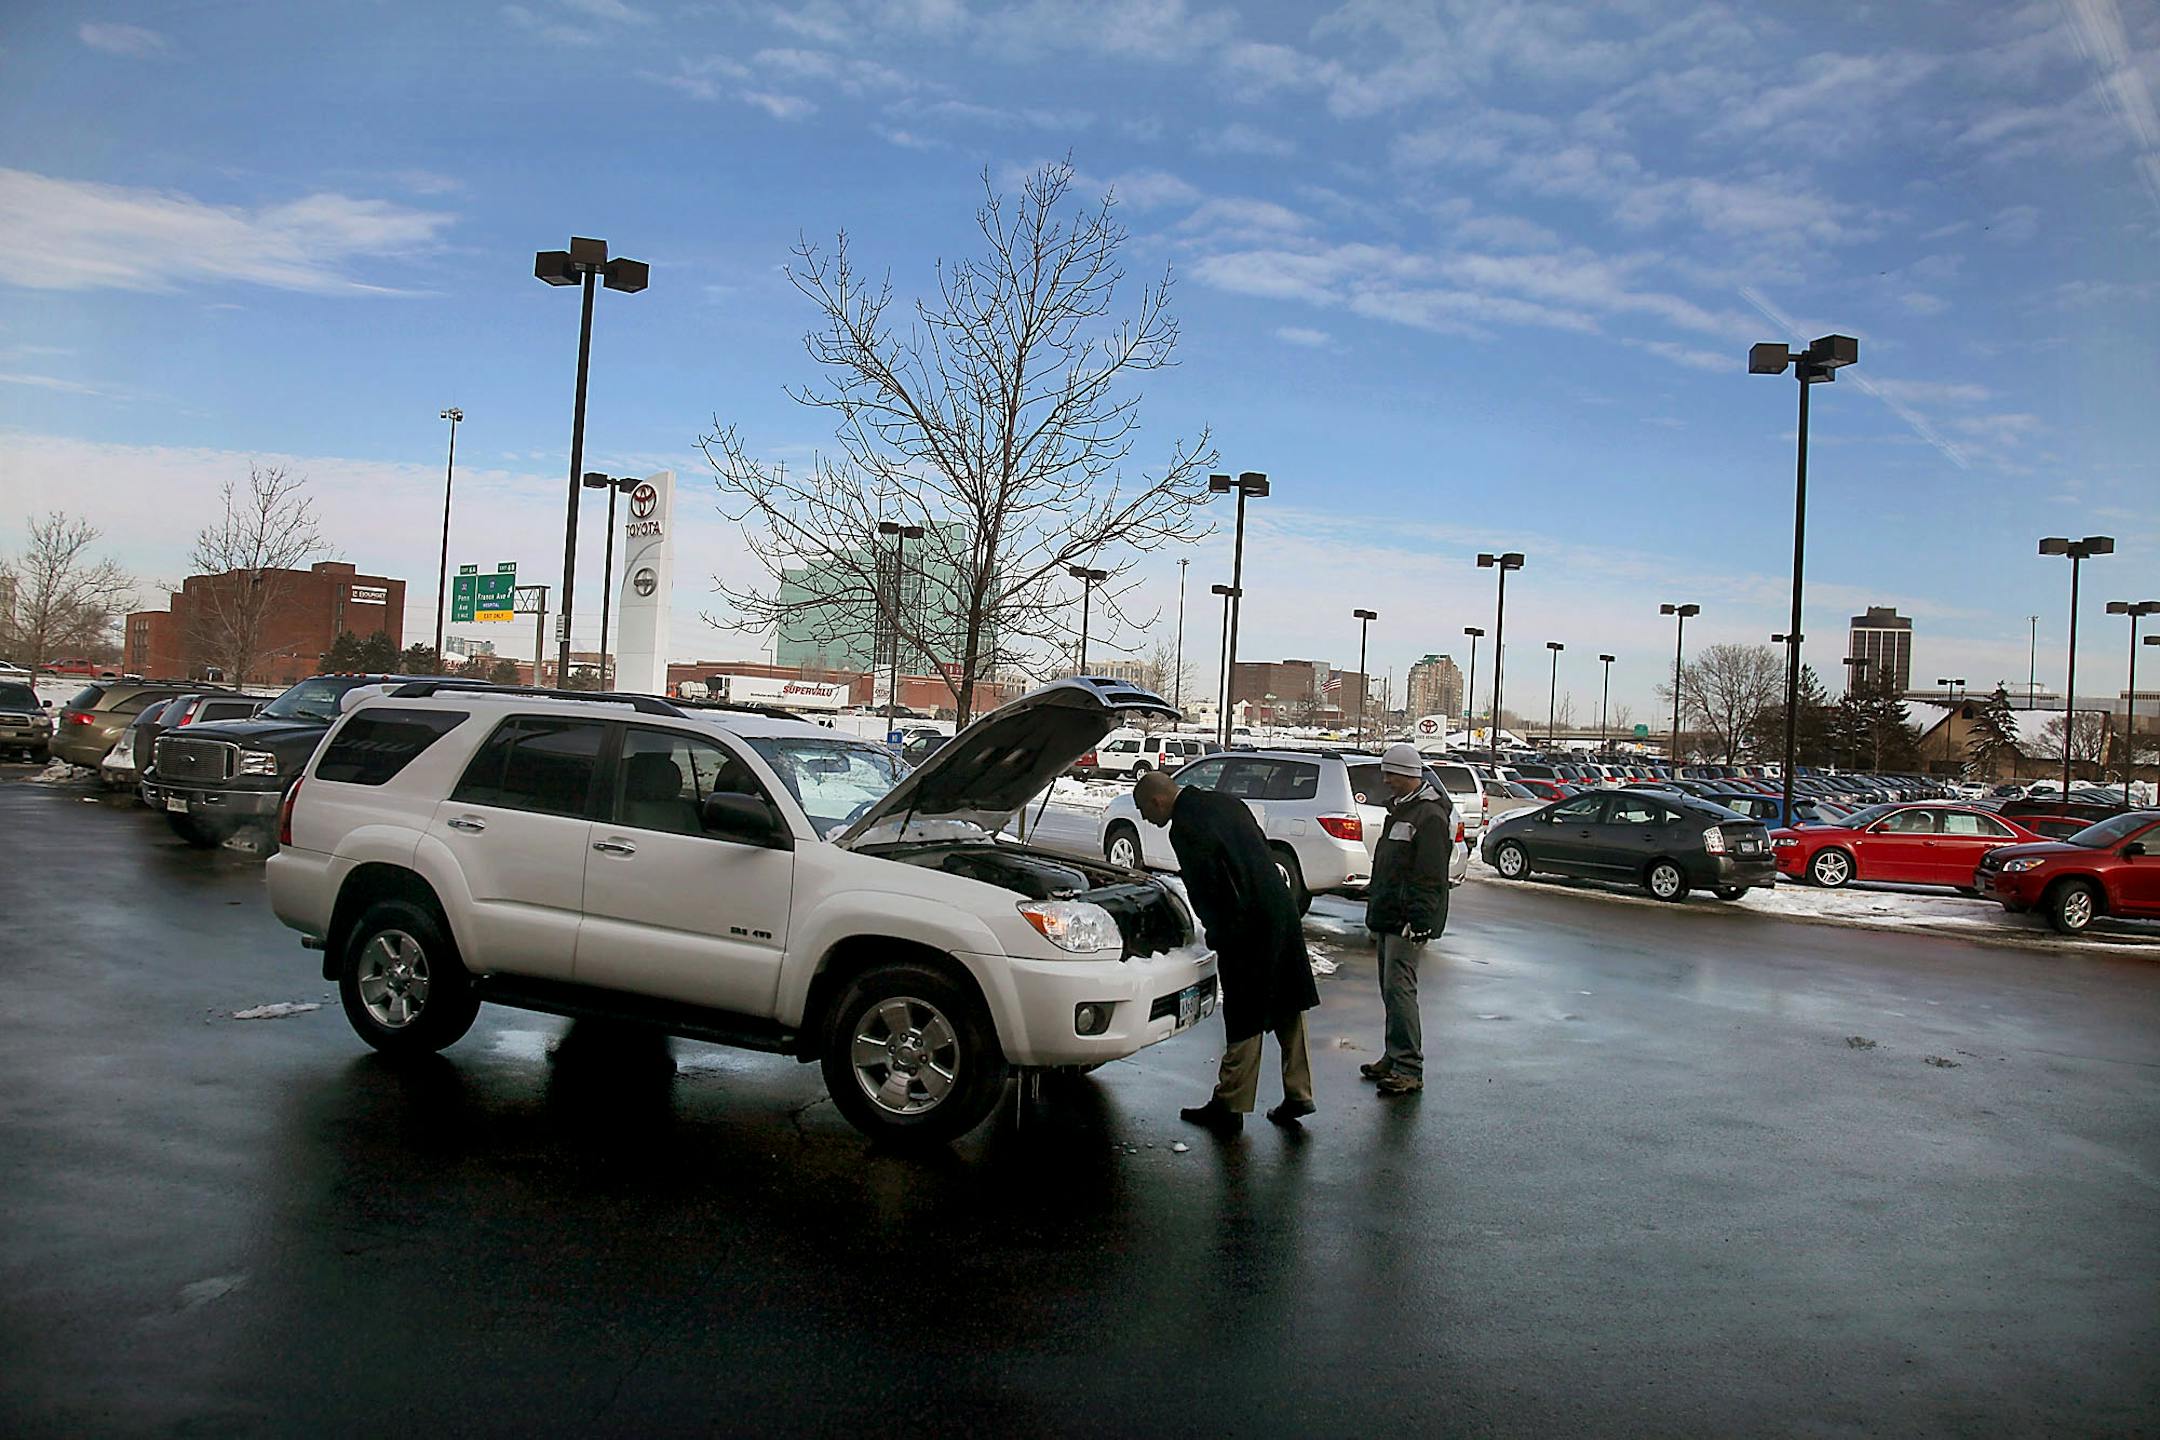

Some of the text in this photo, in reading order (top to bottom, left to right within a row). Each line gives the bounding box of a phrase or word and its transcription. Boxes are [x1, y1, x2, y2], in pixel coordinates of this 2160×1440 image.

[625, 521, 662, 537] TOYOTA
[496, 592, 506, 600] Ave
[783, 684, 833, 698] SUPERVALU
